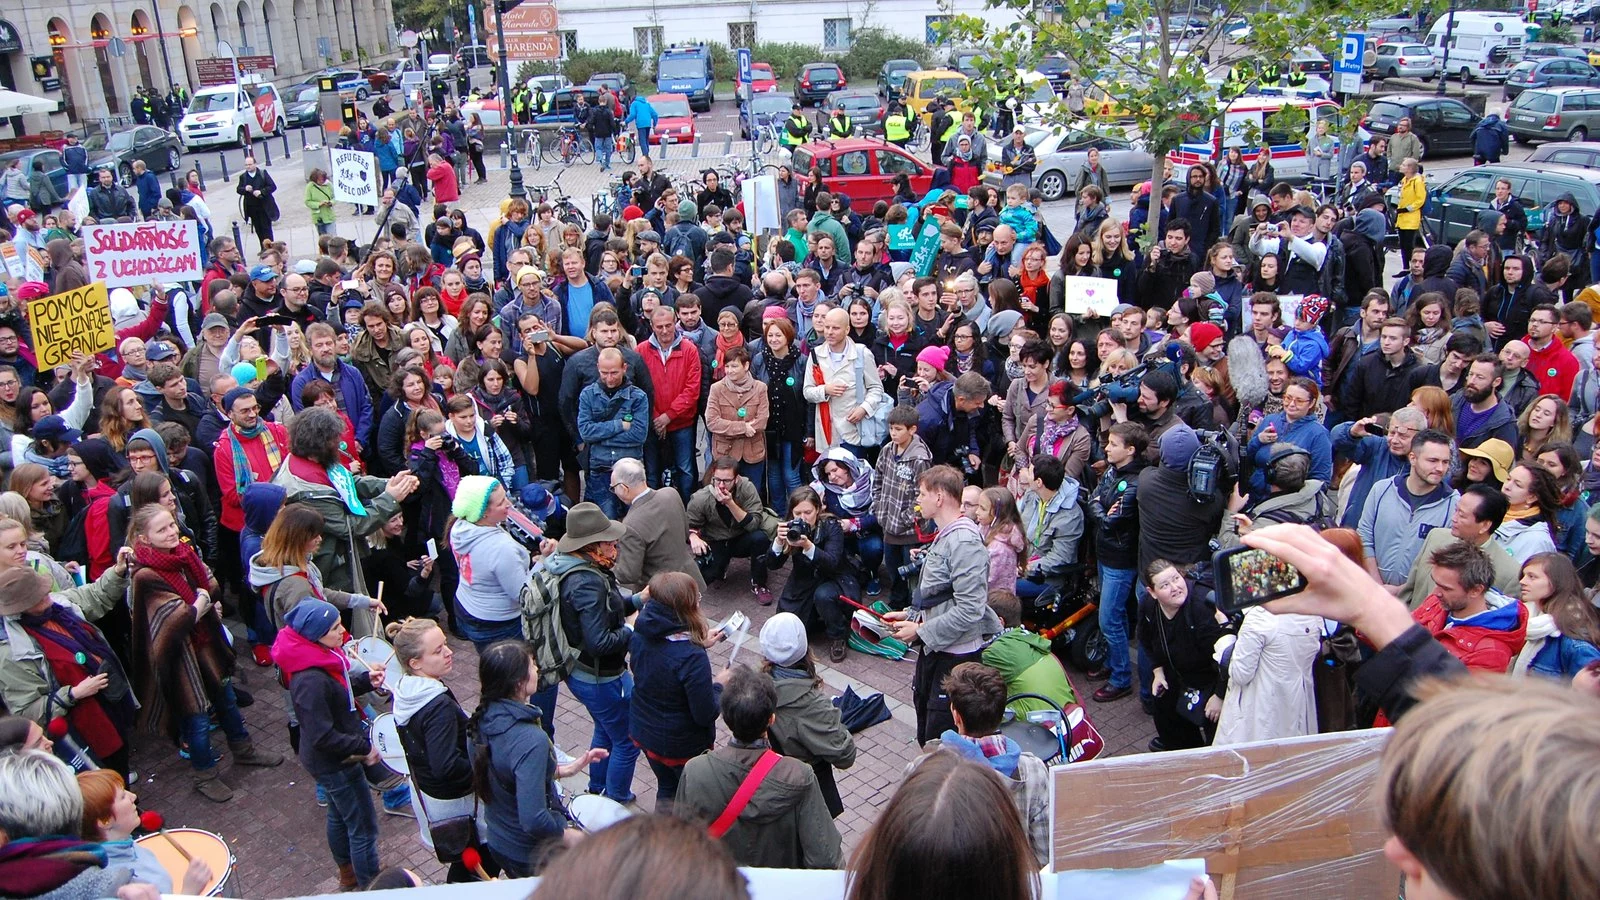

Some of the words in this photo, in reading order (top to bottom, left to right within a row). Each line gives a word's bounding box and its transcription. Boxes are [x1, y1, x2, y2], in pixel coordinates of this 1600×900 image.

[501, 11, 525, 20] Hotel
[502, 19, 539, 28] Harenda
[505, 42, 554, 52] HARENDA
[1340, 37, 1358, 68] P
[741, 53, 749, 79] P
[336, 153, 369, 170] REFUGEES
[338, 180, 371, 195] WELCOME
[94, 260, 108, 279] Z
[33, 286, 98, 326] POMOC
[35, 322, 64, 347] NIE
[65, 305, 111, 339] UZNAJE
[44, 329, 108, 366] GRANIC
